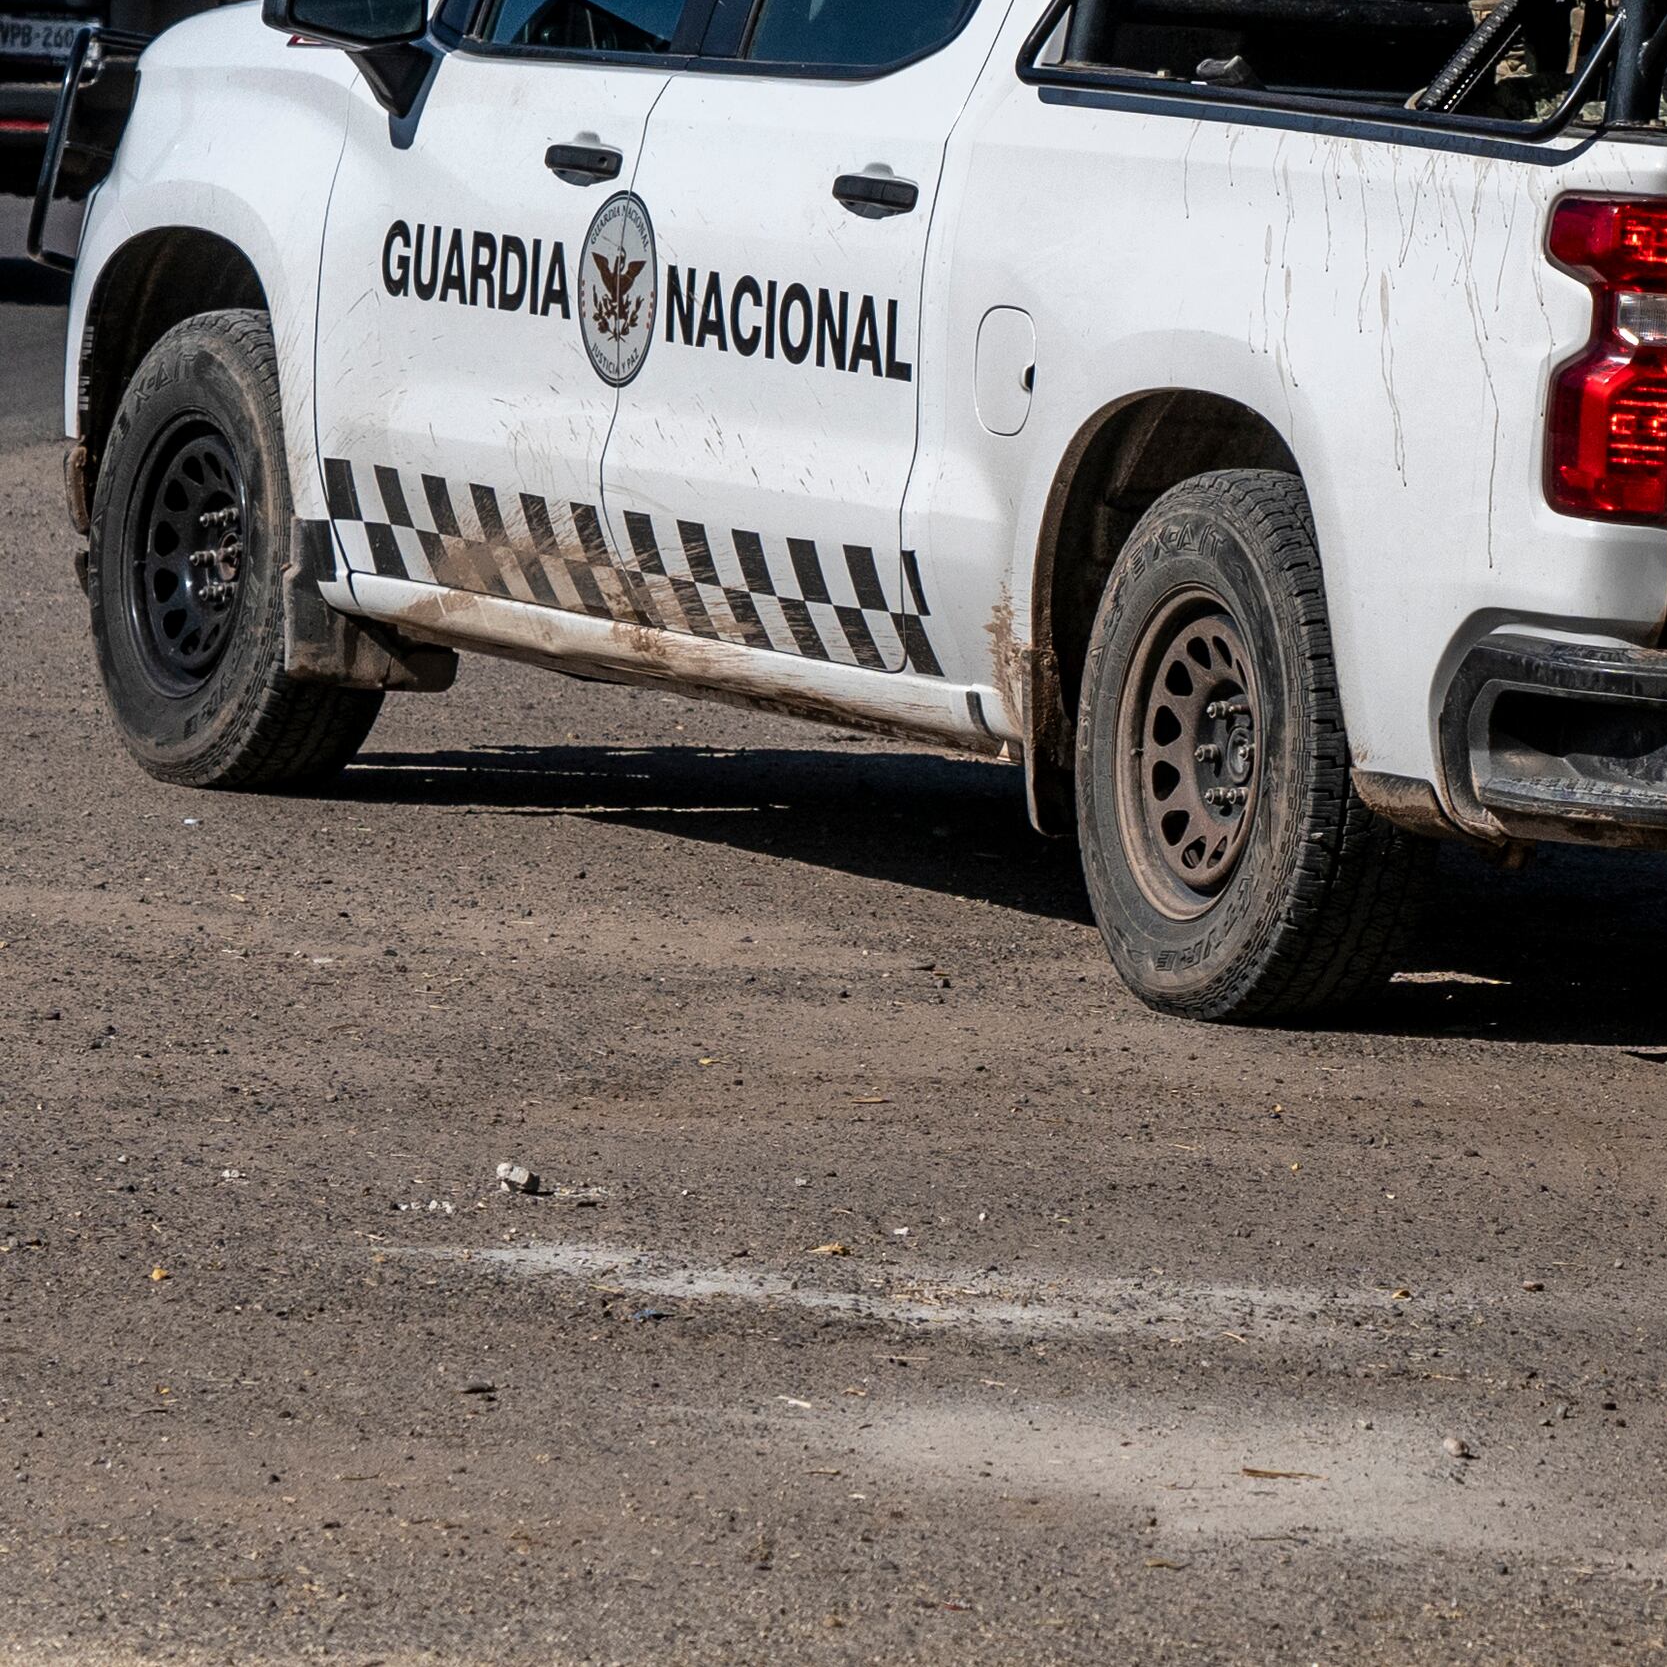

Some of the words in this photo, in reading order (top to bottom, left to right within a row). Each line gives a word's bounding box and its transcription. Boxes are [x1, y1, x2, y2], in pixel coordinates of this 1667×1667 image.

[590, 205, 623, 245] GUARDIA
[622, 205, 650, 252] NACIONAL
[381, 219, 571, 320] GUARDIA
[664, 264, 912, 382] NACIONAL
[591, 343, 620, 375] JUSTICIA
[626, 347, 641, 371] PAZ
